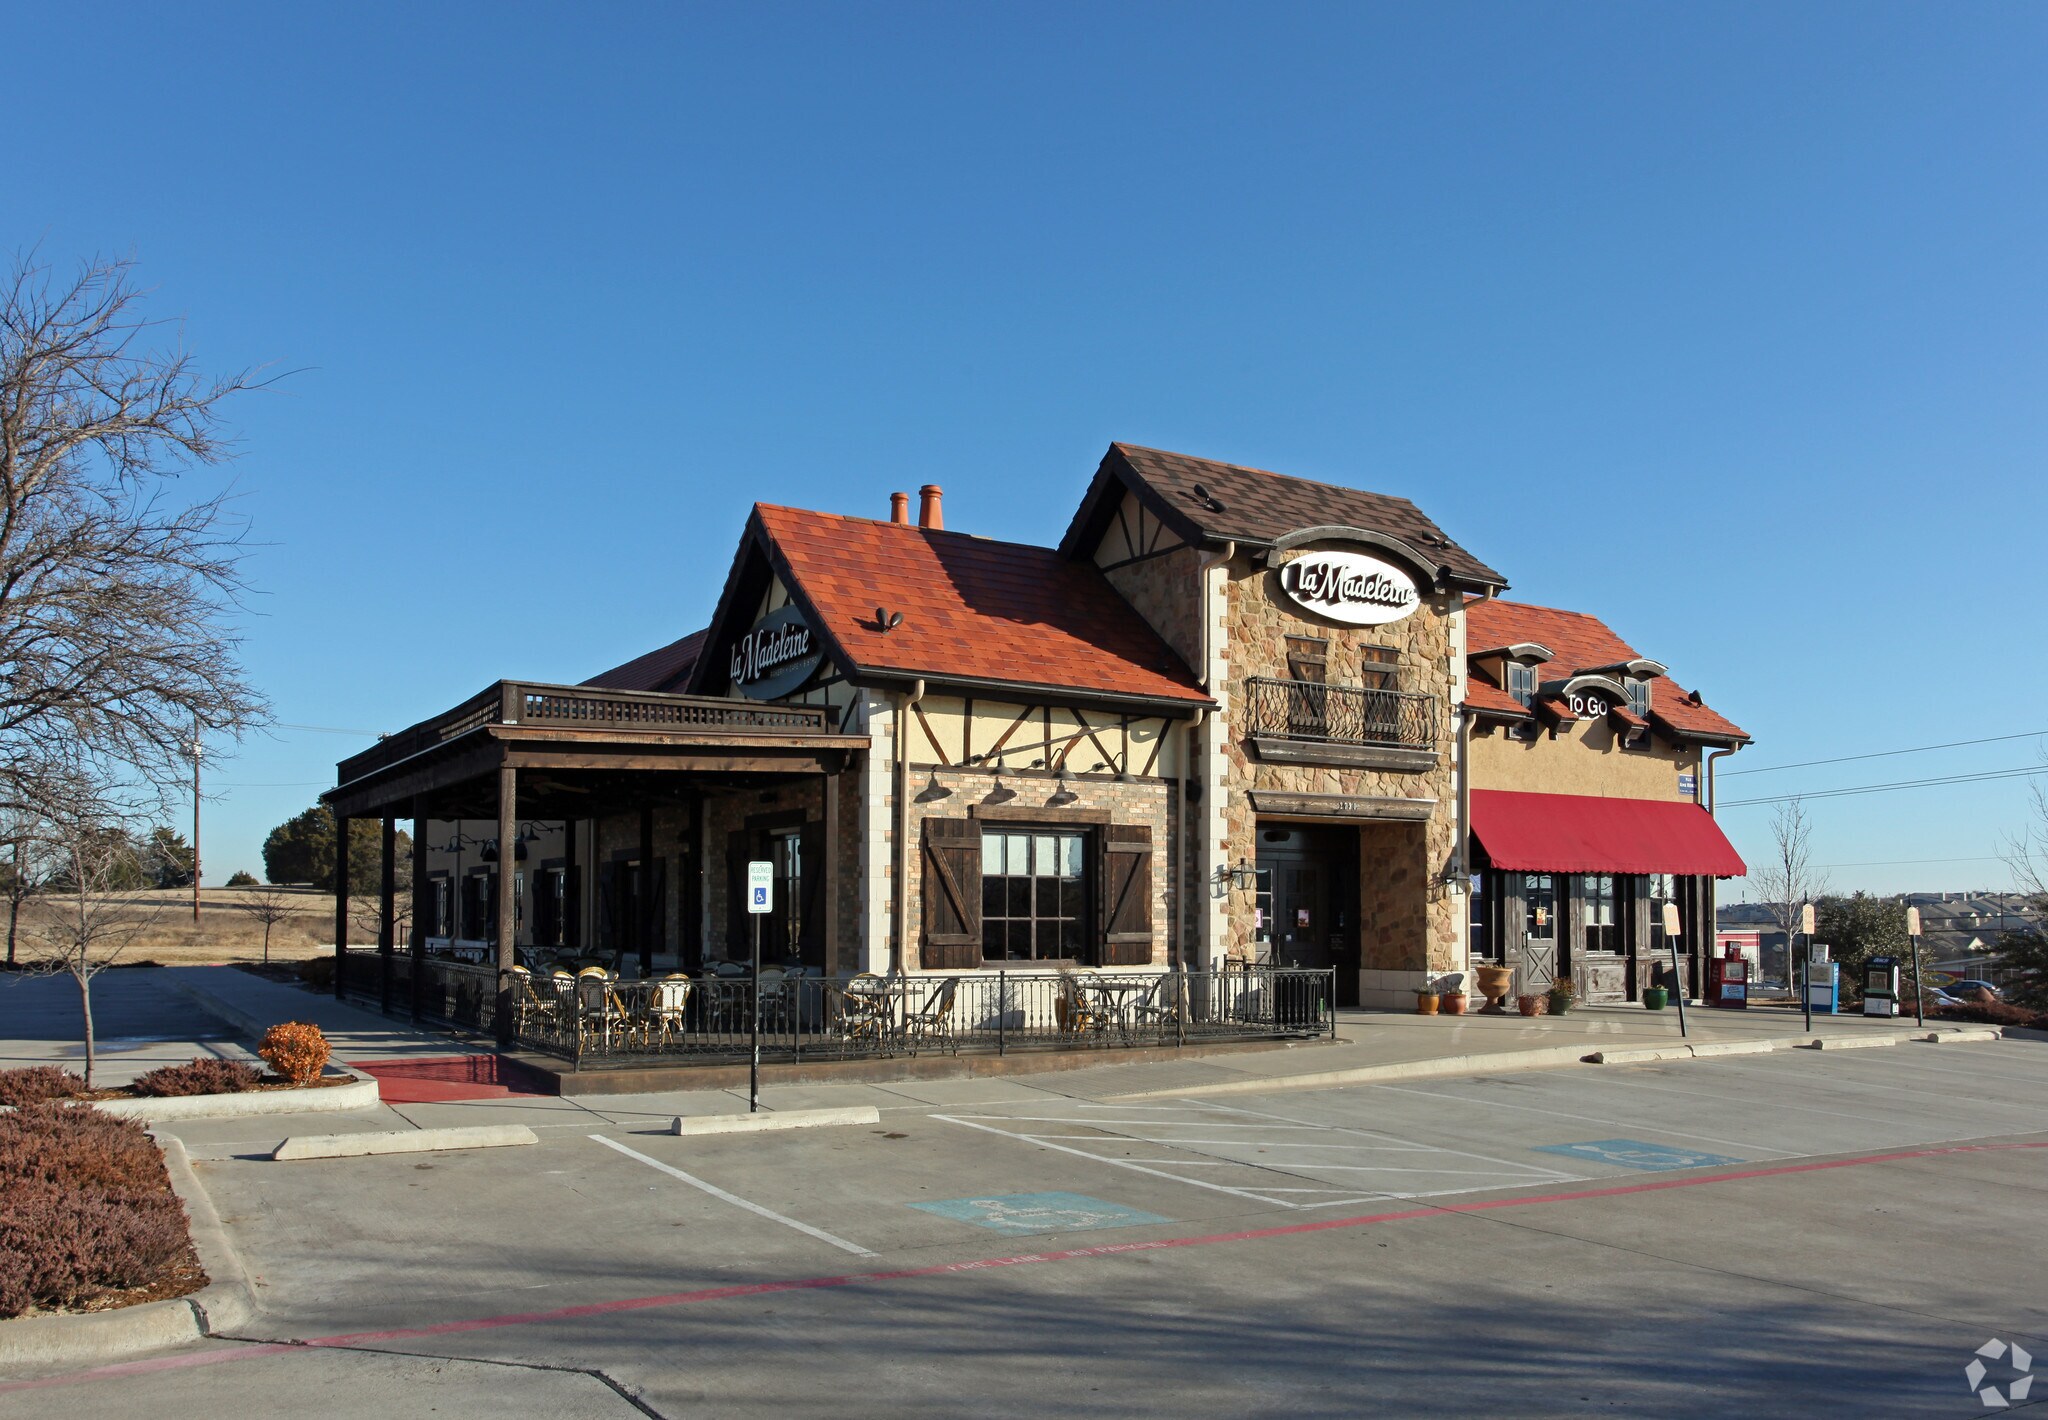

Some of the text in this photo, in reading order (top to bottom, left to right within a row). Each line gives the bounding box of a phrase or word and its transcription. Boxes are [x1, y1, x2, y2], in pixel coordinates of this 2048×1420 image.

[1298, 561, 1415, 604] la Madeleine
[730, 643, 742, 679] la
[736, 622, 810, 684] Madeleine
[1568, 694, 1608, 716] To Go
[947, 1242, 1167, 1272] FIRE LANE NO PARKING
